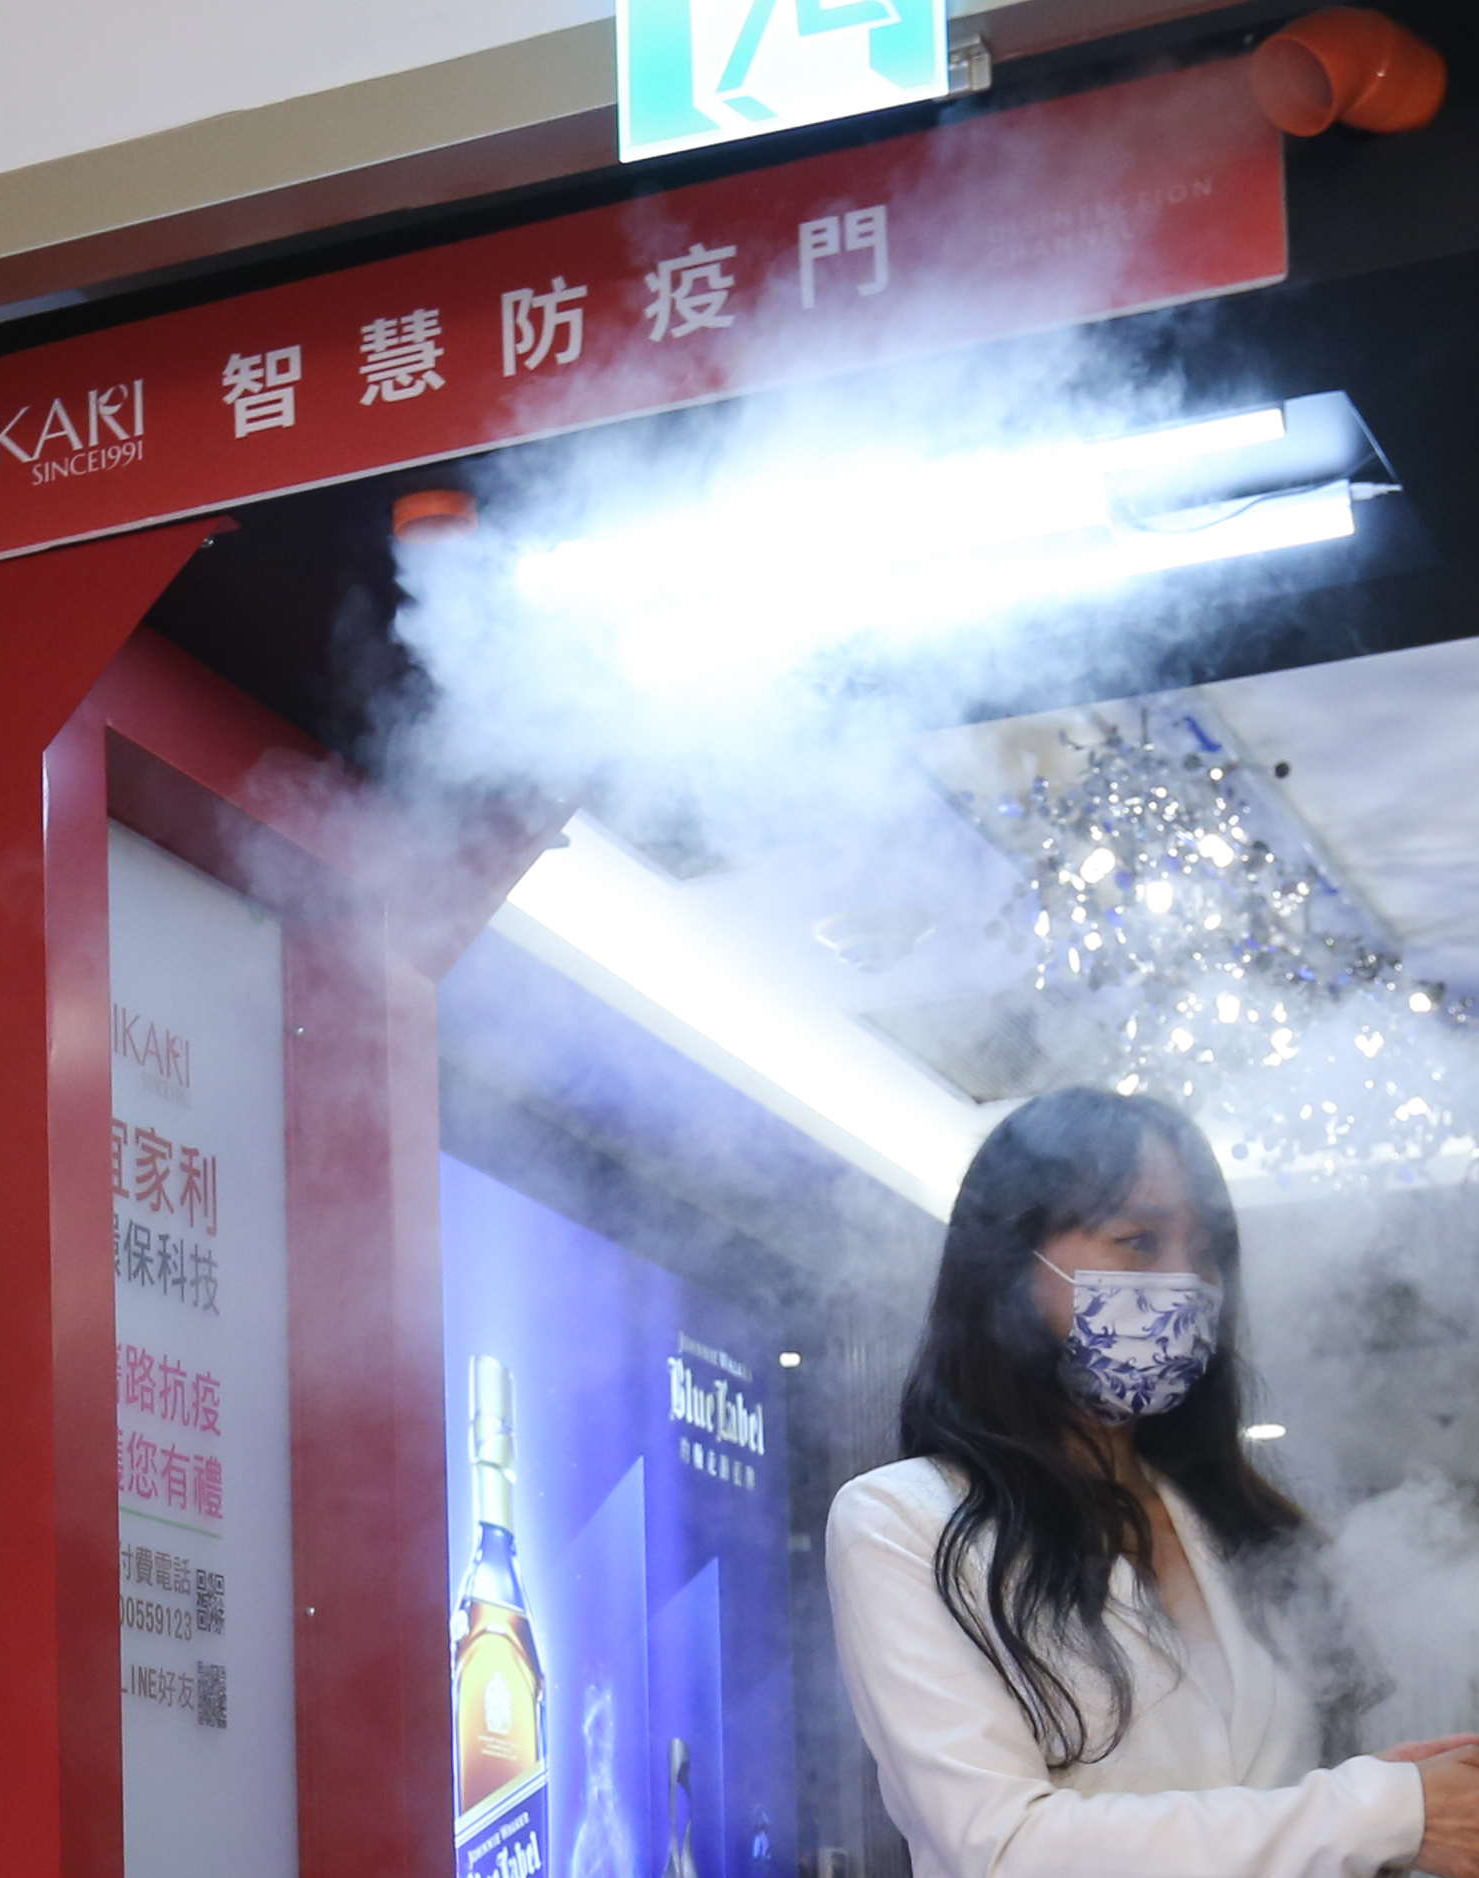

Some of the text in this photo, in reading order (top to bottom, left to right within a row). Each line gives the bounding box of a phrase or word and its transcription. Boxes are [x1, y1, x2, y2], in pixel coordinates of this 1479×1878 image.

[222, 205, 888, 438] 智慧防疫門
[32, 440, 144, 486] SINCE1991
[114, 1212, 220, 1316] 保科技
[116, 1342, 221, 1436] 路抗疫
[667, 1356, 766, 1456] Blue Label
[117, 1428, 224, 1519] 您有禮
